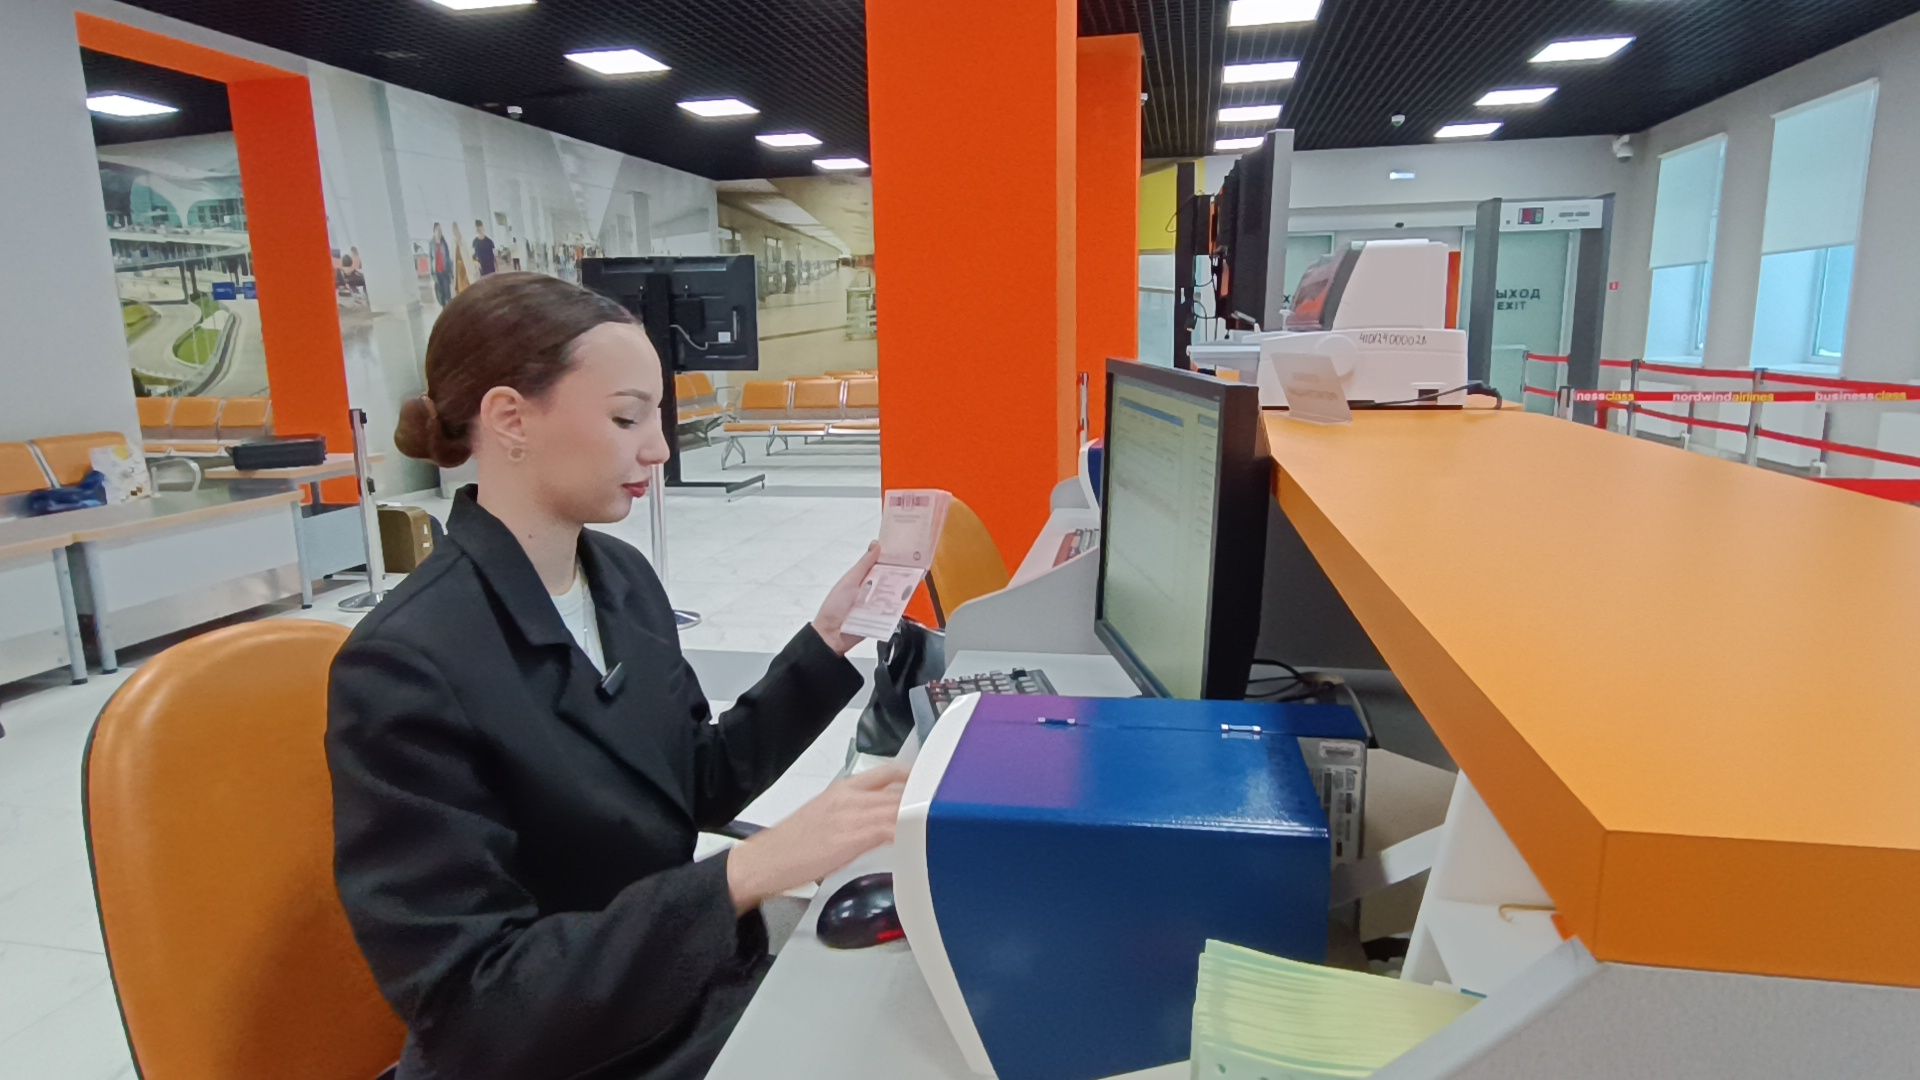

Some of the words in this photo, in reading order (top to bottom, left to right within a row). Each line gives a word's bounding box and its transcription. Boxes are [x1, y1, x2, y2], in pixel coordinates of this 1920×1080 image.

[1496, 288, 1540, 299] ЫХОД
[1497, 301, 1526, 310] EXIT
[1576, 391, 1635, 401] nessclass
